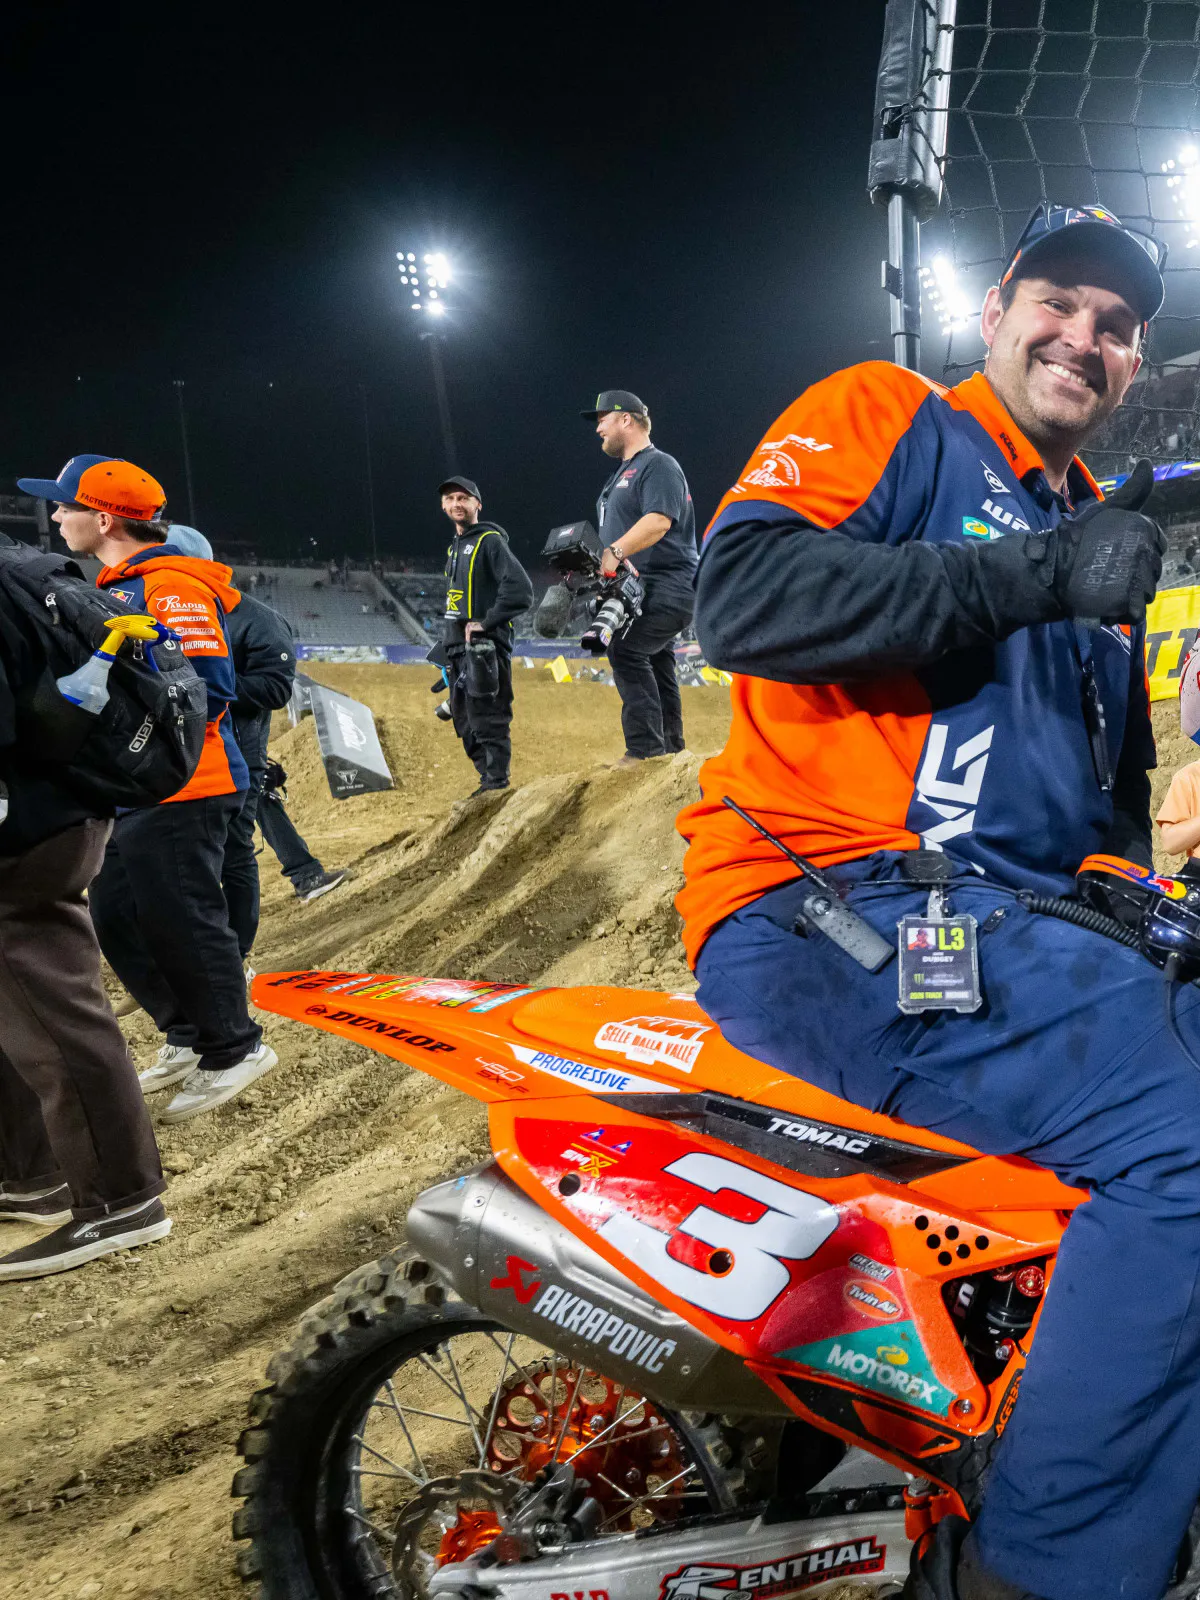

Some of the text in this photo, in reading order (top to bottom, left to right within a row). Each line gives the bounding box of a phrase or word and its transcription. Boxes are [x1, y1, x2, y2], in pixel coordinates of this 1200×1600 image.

[81, 492, 144, 517] FACTORY RACING
[166, 615, 209, 625] PROGRESSIVE
[938, 927, 966, 951] L3
[324, 1010, 457, 1054] DUNLOP
[601, 1024, 632, 1044] SELLE
[631, 1034, 663, 1053] DALLA
[664, 1042, 696, 1064] VALLE
[474, 1056, 526, 1083] 450
[530, 1051, 631, 1091] PROGRESSIVE
[767, 1117, 871, 1154] TOMAC
[597, 1152, 840, 1321] 3
[849, 1284, 899, 1315] Twin Air
[827, 1343, 940, 1406] MOTOREX
